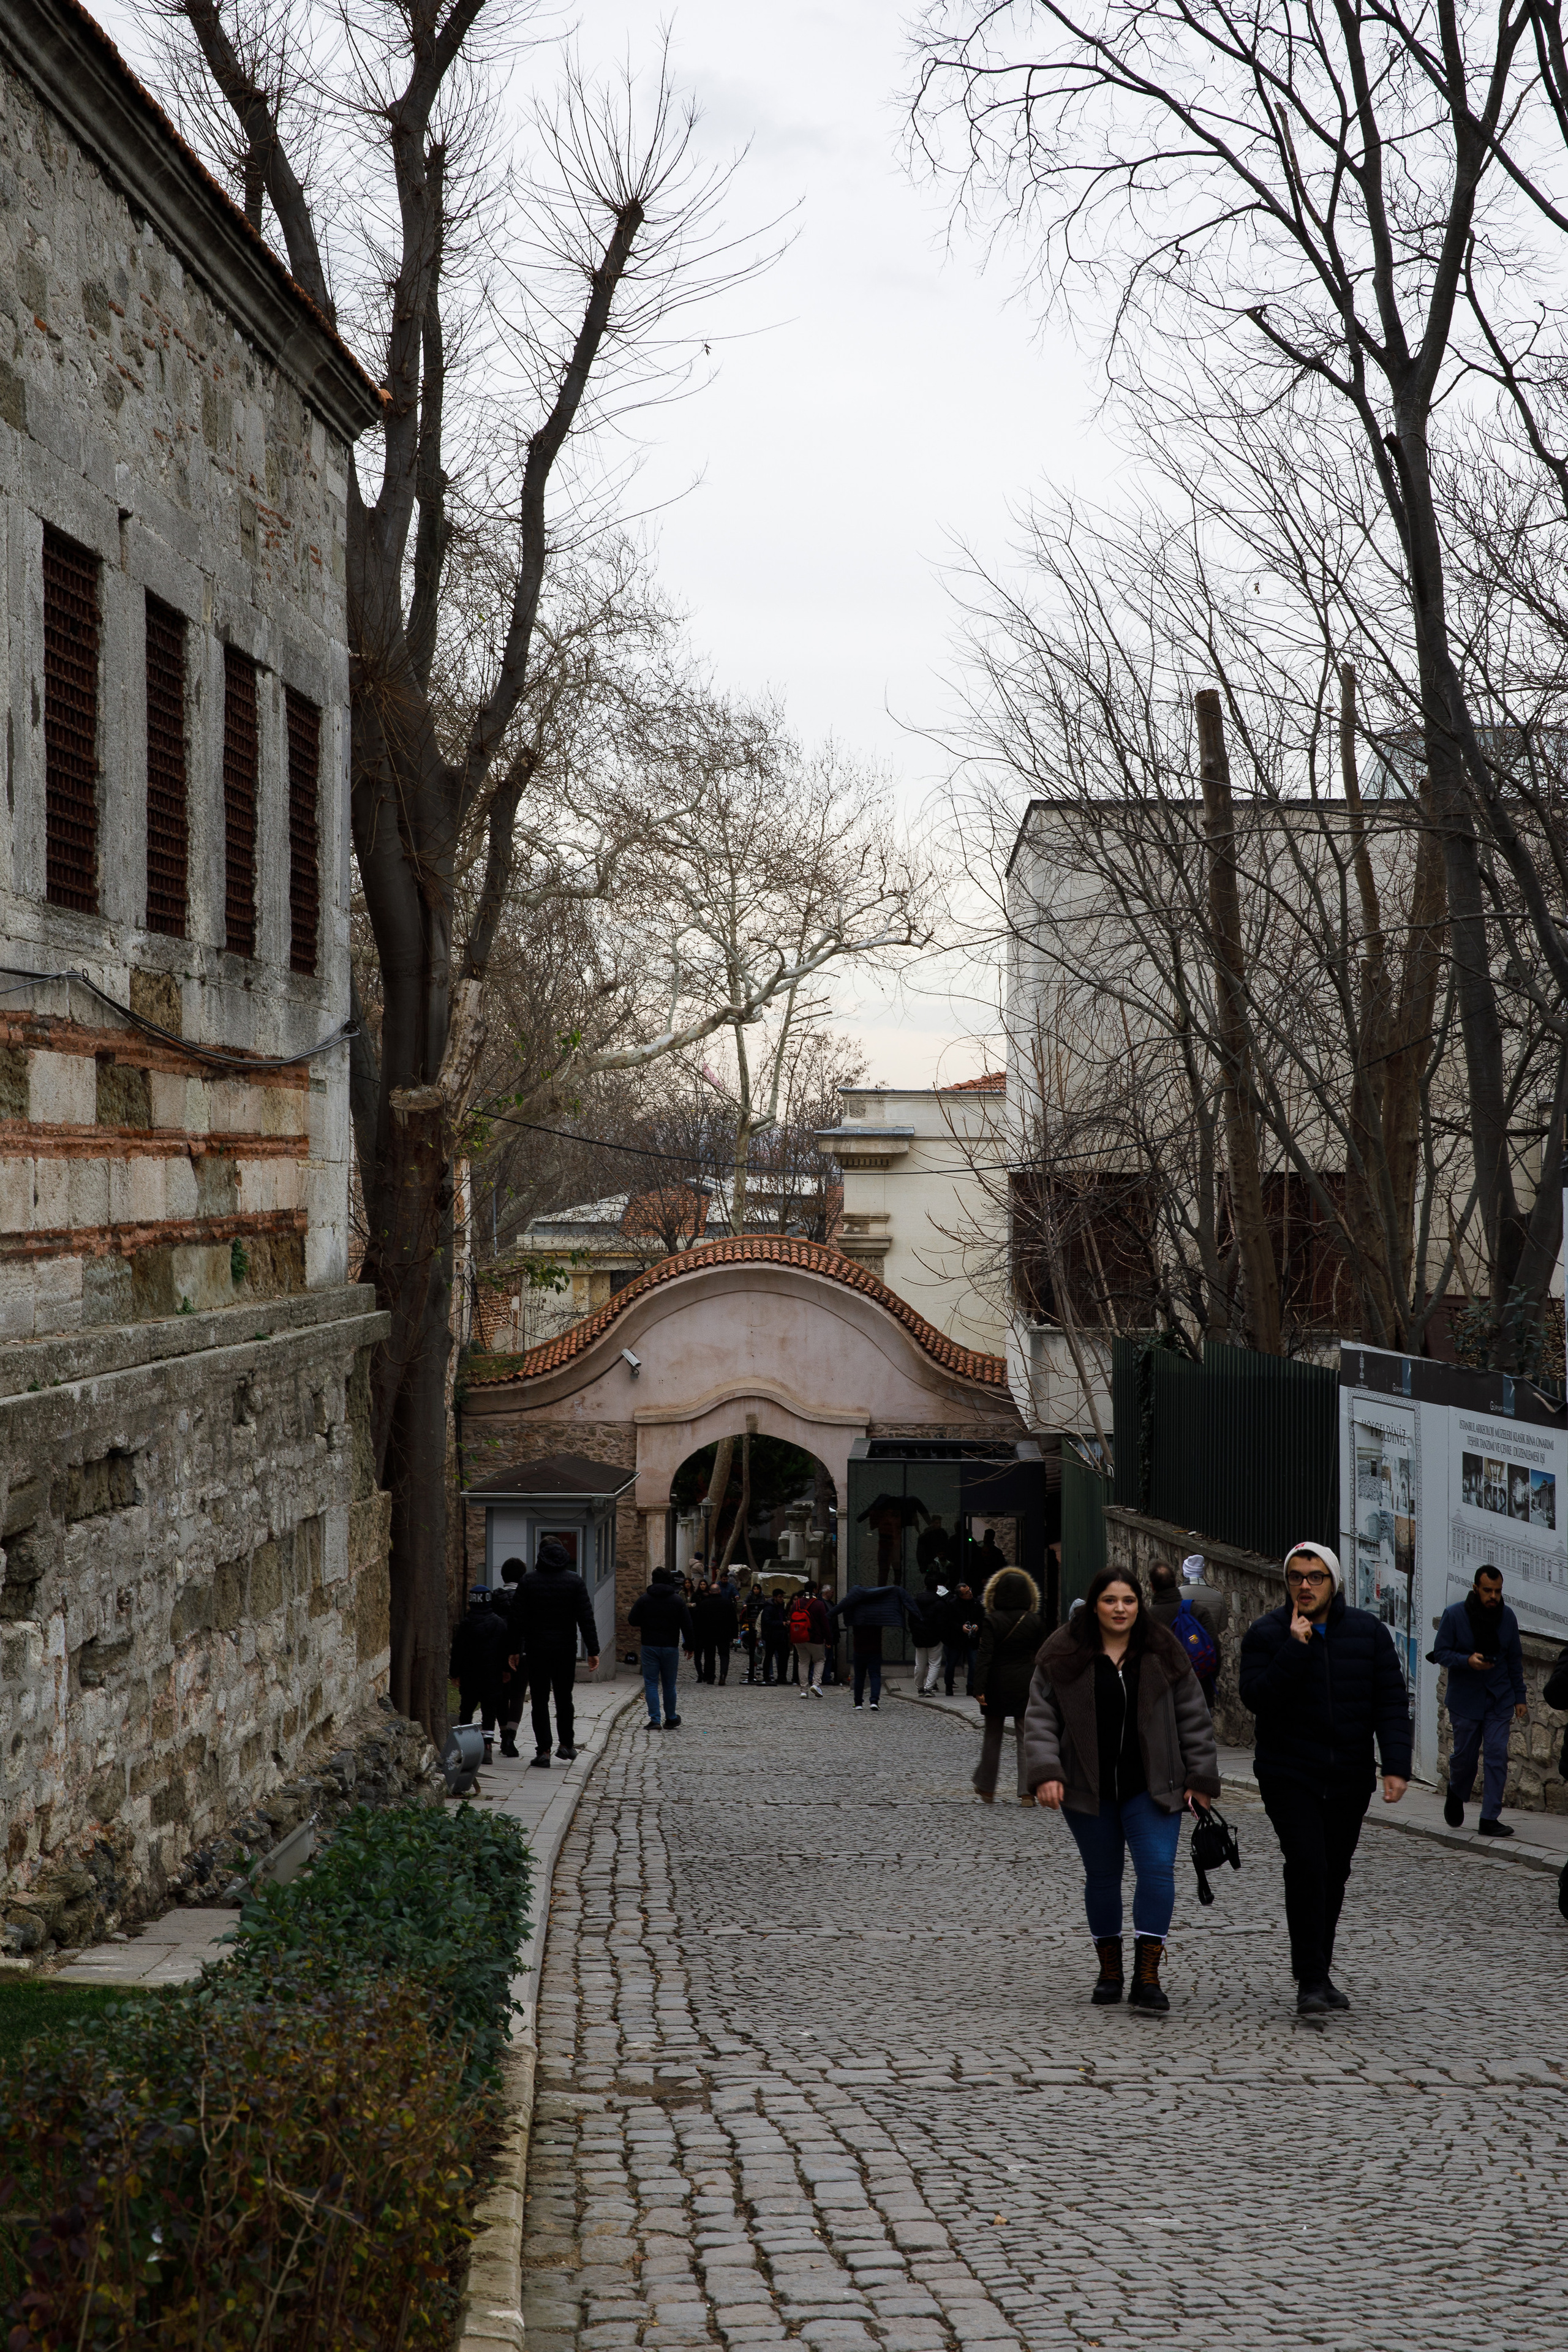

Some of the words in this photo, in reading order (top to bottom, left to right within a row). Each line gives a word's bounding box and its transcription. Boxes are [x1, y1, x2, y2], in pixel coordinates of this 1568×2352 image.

[1513, 1431, 1526, 1444] KLASİK
[1526, 1433, 1536, 1446] BİNA
[1495, 1442, 1500, 1452] VE
[1500, 1444, 1512, 1455] ÇEVRE
